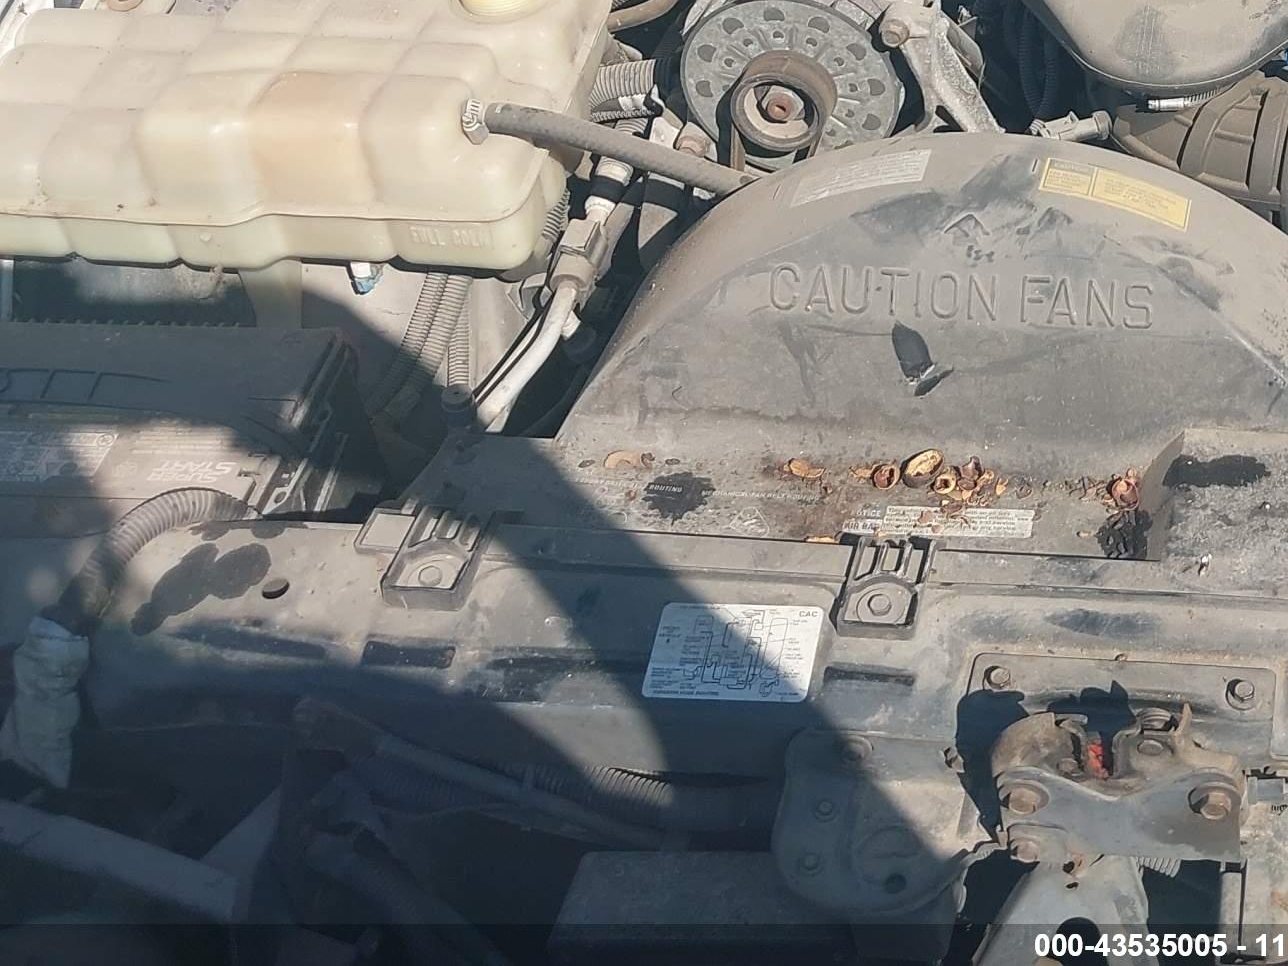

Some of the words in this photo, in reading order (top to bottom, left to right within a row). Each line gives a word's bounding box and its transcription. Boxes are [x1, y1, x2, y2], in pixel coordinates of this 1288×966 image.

[769, 261, 998, 322] CAUTION
[1020, 274, 1154, 330] FANS
[648, 483, 684, 494] ROUTING
[799, 610, 818, 618] CAC
